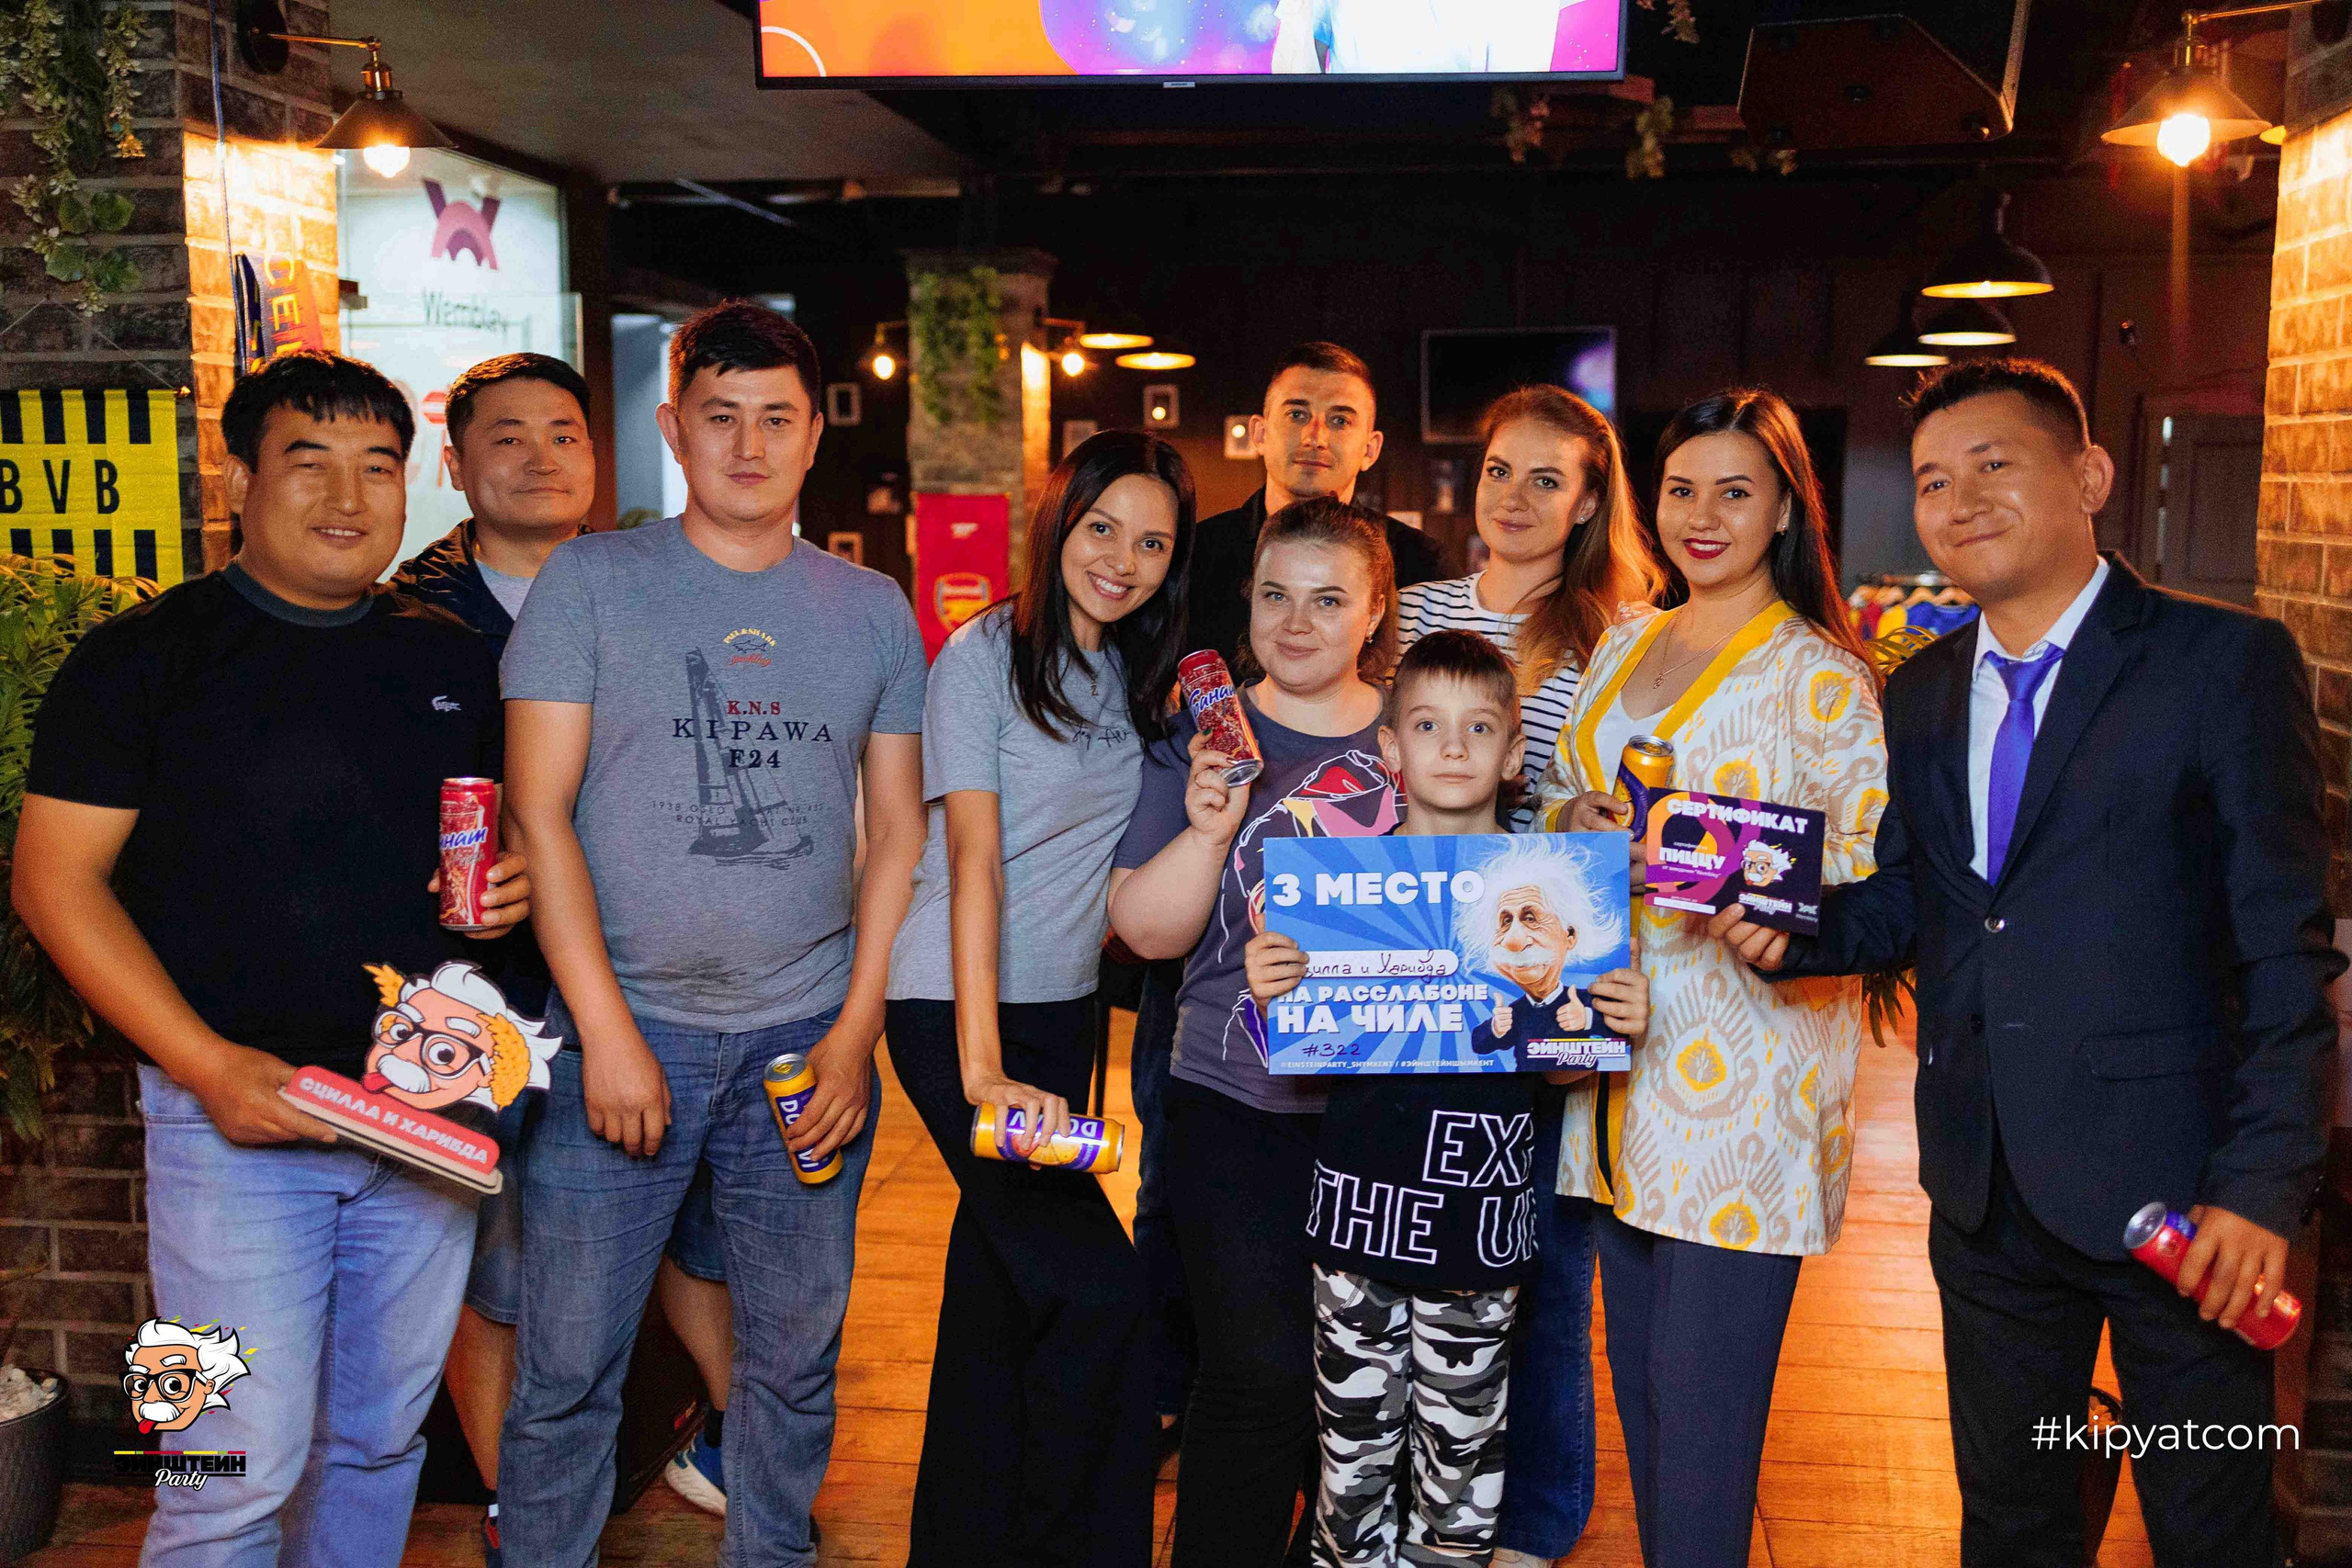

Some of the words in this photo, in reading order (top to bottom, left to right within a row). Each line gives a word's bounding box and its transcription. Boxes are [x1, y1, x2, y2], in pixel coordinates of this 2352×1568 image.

[726, 700, 781, 716] K.N.S
[672, 717, 833, 742] KIPAWA
[729, 749, 782, 769] F24
[676, 814, 720, 826] ROYAL
[1667, 798, 1808, 835] СЕРТИФИКАТ
[1659, 847, 1726, 871] ПИЦЦУ
[1272, 873, 1302, 908] 3
[1316, 870, 1486, 906] МЕСТО
[1317, 984, 1489, 1004] РАССЛАБОНЕ
[1277, 1006, 1340, 1034] НА
[1351, 1004, 1464, 1033] ЧИЛЕ
[1302, 1043, 1362, 1057] #322
[1556, 1052, 1599, 1068] Party
[300, 1077, 380, 1121] СЦИЛЛА
[383, 1111, 400, 1127] И
[399, 1117, 488, 1164] ХАРИБДА
[1306, 1158, 1444, 1265] THE
